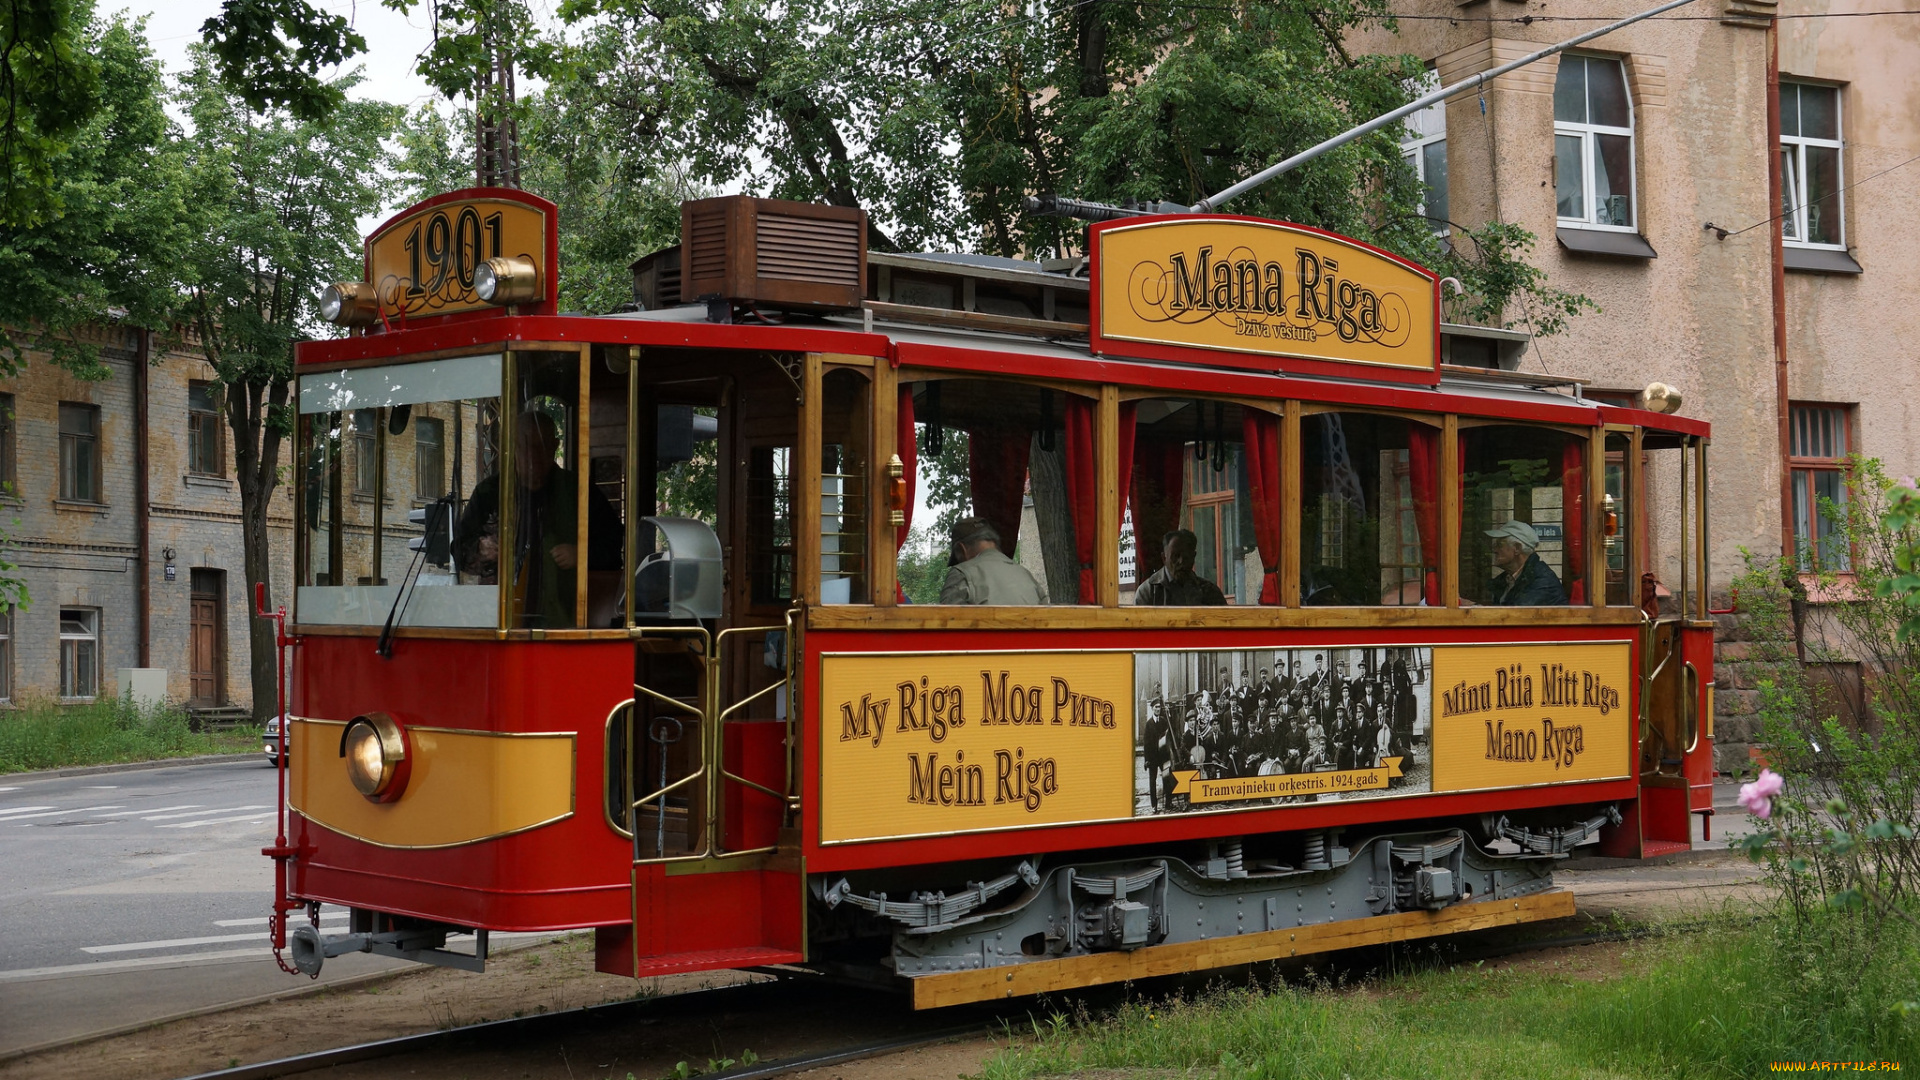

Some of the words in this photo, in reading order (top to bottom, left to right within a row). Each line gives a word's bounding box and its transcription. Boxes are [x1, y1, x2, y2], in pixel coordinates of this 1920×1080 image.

[405, 206, 502, 299] 1901
[1170, 245, 1286, 316] Mana
[1295, 247, 1381, 343] Rīga
[1235, 318, 1270, 338] Dzīva
[1272, 321, 1317, 342] vēsture
[840, 693, 890, 748] My
[896, 675, 966, 743] Riga
[980, 670, 1044, 726] Моя
[1051, 676, 1117, 729] Рига
[1442, 680, 1492, 717] Minu
[1495, 663, 1533, 710] Riia
[1540, 663, 1579, 707] Mitt
[1582, 670, 1620, 715] Riga
[1485, 720, 1537, 762] Mano
[1542, 717, 1584, 770] Ryga
[907, 750, 986, 806] Mein
[993, 747, 1058, 813] Riga
[1202, 780, 1276, 797] Tramvajnieku
[1279, 777, 1327, 794] orķestris.
[1330, 772, 1379, 789] 1924.gads
